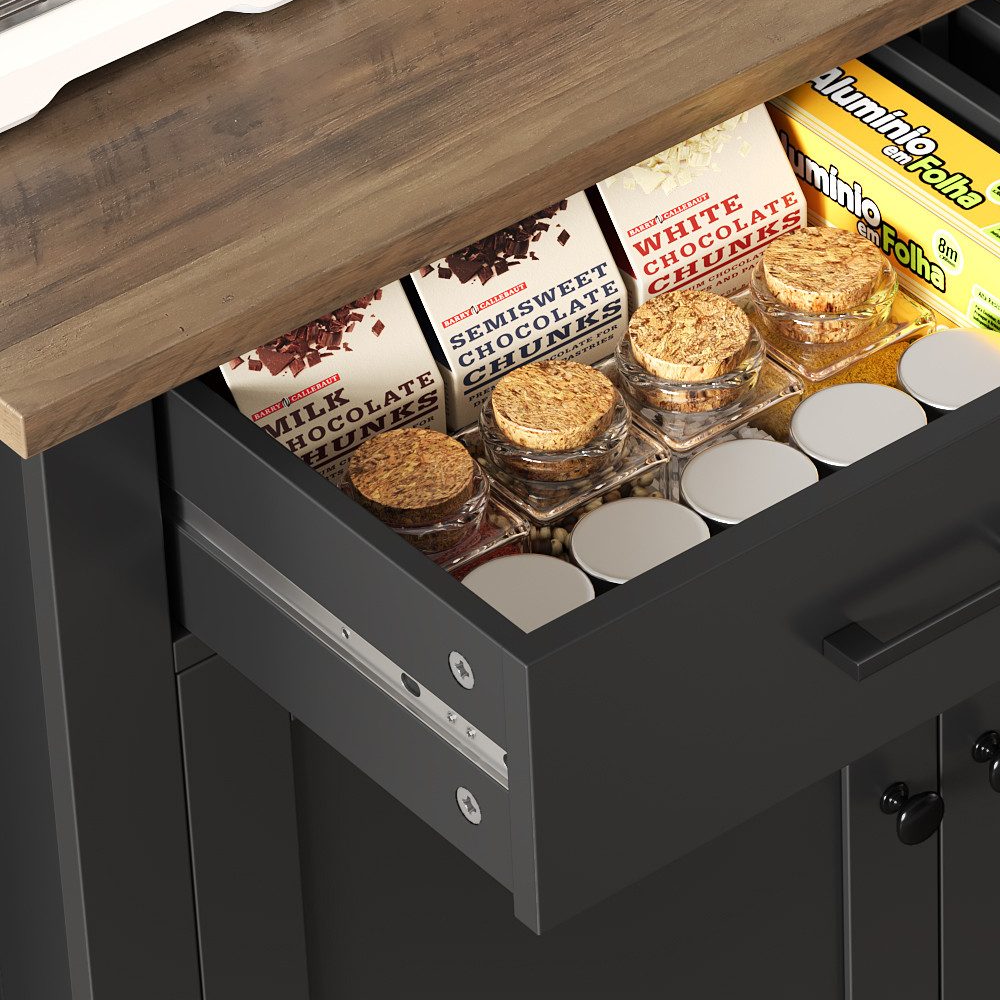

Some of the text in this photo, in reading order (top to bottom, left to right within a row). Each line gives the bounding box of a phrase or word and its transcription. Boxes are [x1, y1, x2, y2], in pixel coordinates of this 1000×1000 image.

[882, 145, 986, 210] em Folha
[629, 193, 709, 237] BARRY CALLEBAUT
[633, 194, 744, 257] WHITE
[643, 191, 798, 276] CHOCOLATE
[647, 209, 801, 295] CHUNKS
[709, 251, 764, 282] CHOCOLAT
[716, 272, 739, 287] AND
[857, 220, 880, 247] em
[880, 223, 946, 293] Folha
[938, 237, 958, 262] 8m
[443, 283, 526, 328] BARRY CALLEBAUT
[449, 262, 608, 350] SEMISWEET
[458, 280, 619, 367] CHOCOLATE
[596, 324, 618, 338] FOR
[462, 298, 622, 387] CHUNKS
[254, 374, 339, 420] BARRY CALLEBAUT
[262, 387, 350, 438] MILK
[286, 371, 435, 452] HOCOLATE
[300, 389, 438, 466] HUNKS
